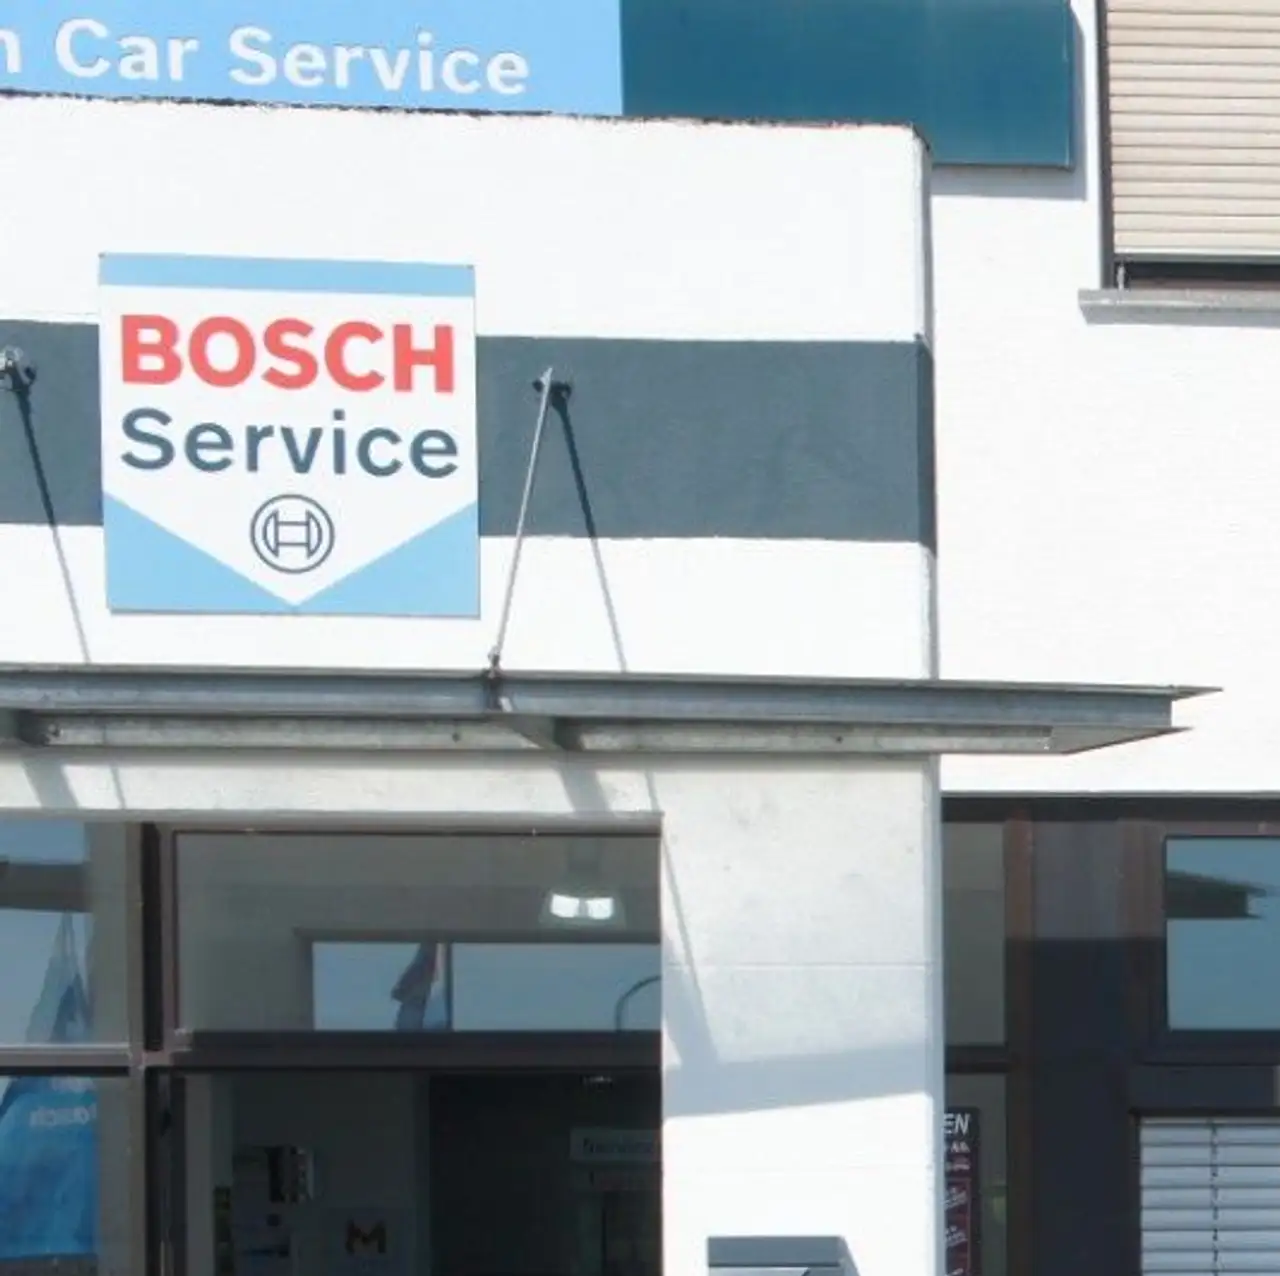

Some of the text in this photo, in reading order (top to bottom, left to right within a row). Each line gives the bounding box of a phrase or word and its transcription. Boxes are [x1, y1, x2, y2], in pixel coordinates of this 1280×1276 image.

[55, 18, 199, 82] Car
[228, 25, 531, 95] Service
[120, 314, 455, 393] BOSCH
[120, 407, 459, 479] Service
